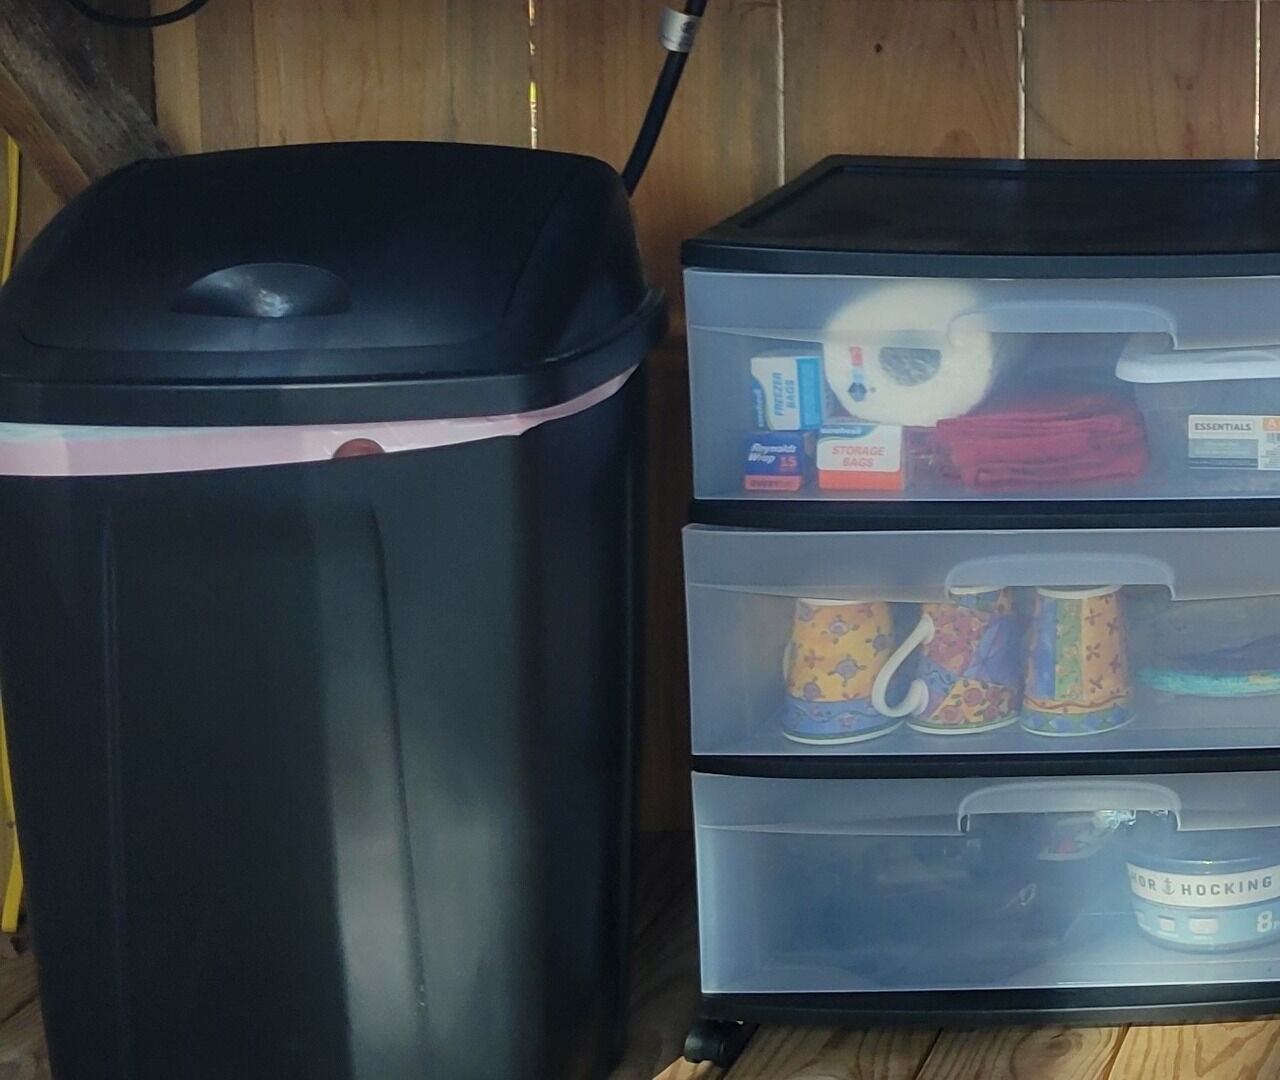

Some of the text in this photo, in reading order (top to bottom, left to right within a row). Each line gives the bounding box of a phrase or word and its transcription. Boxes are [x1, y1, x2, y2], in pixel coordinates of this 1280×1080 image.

[785, 379, 797, 409] BAGS
[1194, 422, 1252, 432] ESSENTIALS
[751, 443, 797, 455] Reynolds
[832, 445, 885, 457] STORAGE
[748, 452, 776, 465] Wrap
[842, 457, 874, 468] BAGS
[1181, 876, 1273, 897] HOCKING
[1256, 910, 1273, 934] 8
